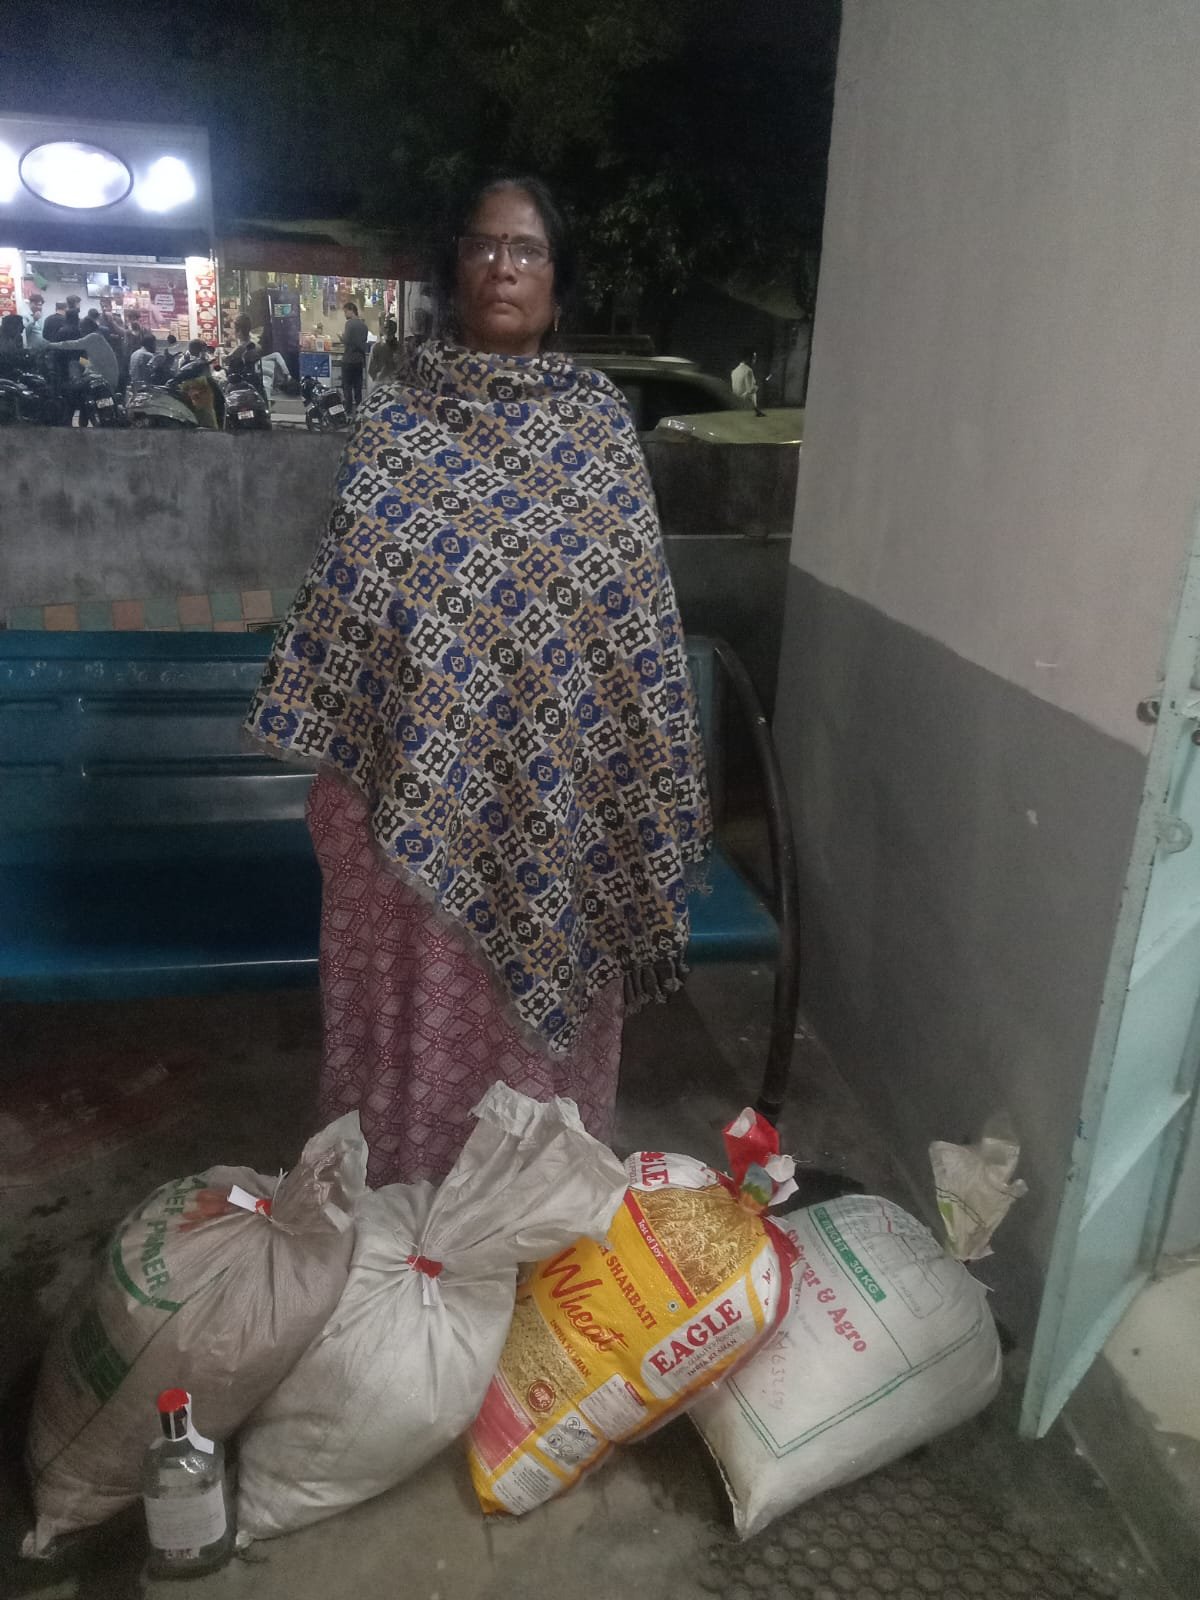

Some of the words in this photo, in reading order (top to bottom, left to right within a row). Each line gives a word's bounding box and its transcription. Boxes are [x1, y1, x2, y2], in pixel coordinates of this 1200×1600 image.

[638, 1218, 648, 1234] Test
[645, 1234, 654, 1244] of
[542, 1248, 630, 1352] Wheat
[605, 1254, 657, 1329] SHARBATI
[849, 1259, 863, 1274] 30
[648, 1298, 742, 1375] EAGLE
[817, 1287, 836, 1304] &
[828, 1306, 866, 1353] Agro
